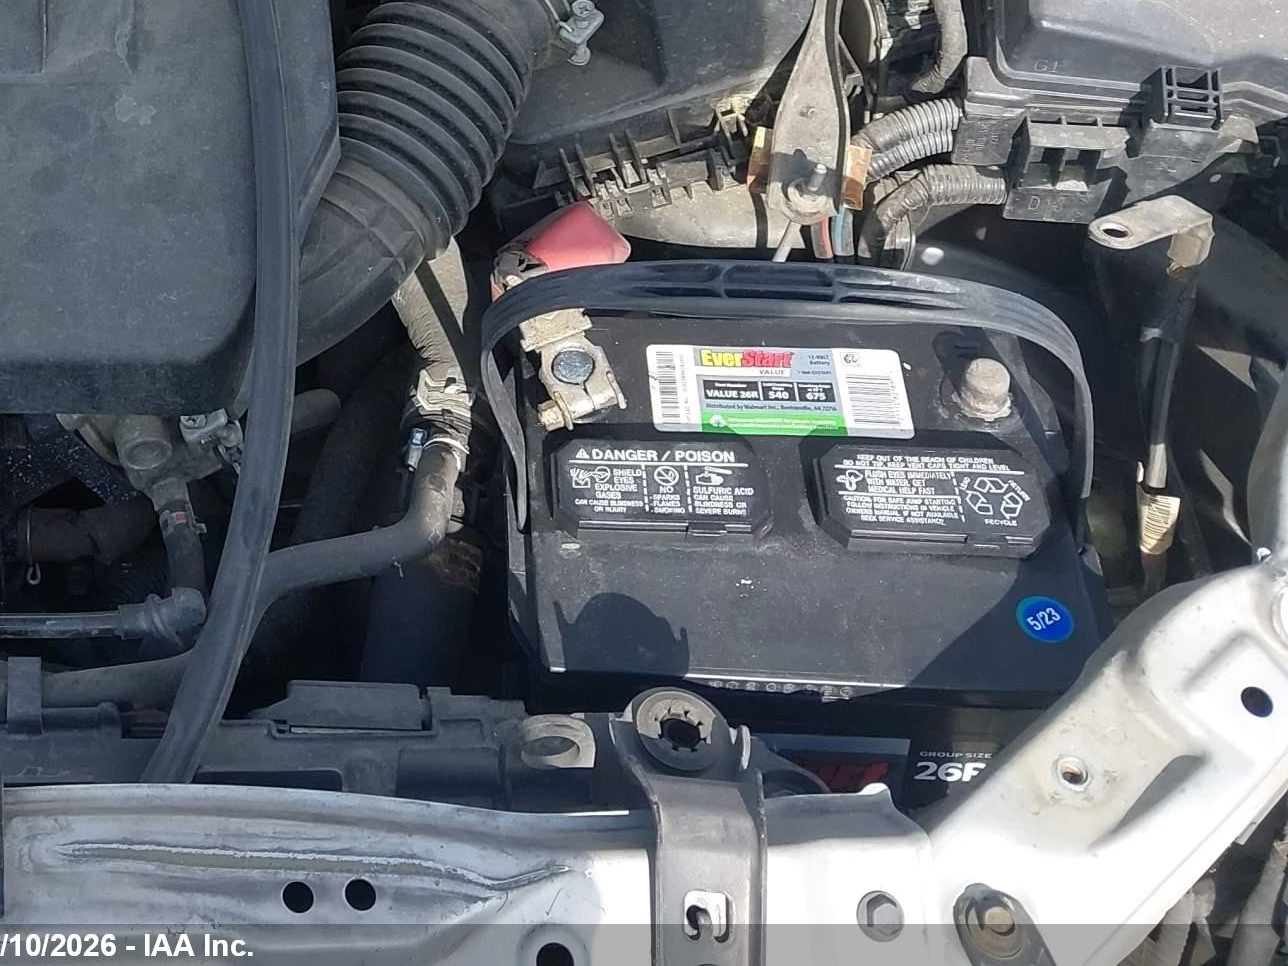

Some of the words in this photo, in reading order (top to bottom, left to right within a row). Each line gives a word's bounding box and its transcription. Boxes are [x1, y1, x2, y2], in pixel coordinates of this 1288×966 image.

[700, 349, 793, 368] EverStart
[706, 389, 739, 398] VALUE
[740, 390, 759, 399] 26R
[768, 391, 789, 400] 540
[806, 392, 826, 401] 675
[592, 449, 658, 461] DANGER
[662, 450, 671, 462] /
[675, 451, 735, 462] POISON
[613, 468, 643, 477] SHIELD
[865, 470, 887, 478] FLUSH
[888, 471, 906, 479] EYES
[907, 471, 951, 480] IMMEDIATELY
[911, 479, 926, 487] GET
[595, 484, 638, 492] EXPLOSIVE
[693, 486, 732, 494] SULFURIC
[734, 487, 754, 495] ACID
[868, 486, 897, 494] MEDICAL
[918, 487, 935, 495] FAST
[1026, 607, 1061, 631] 5/23
[920, 751, 962, 759] GROUP
